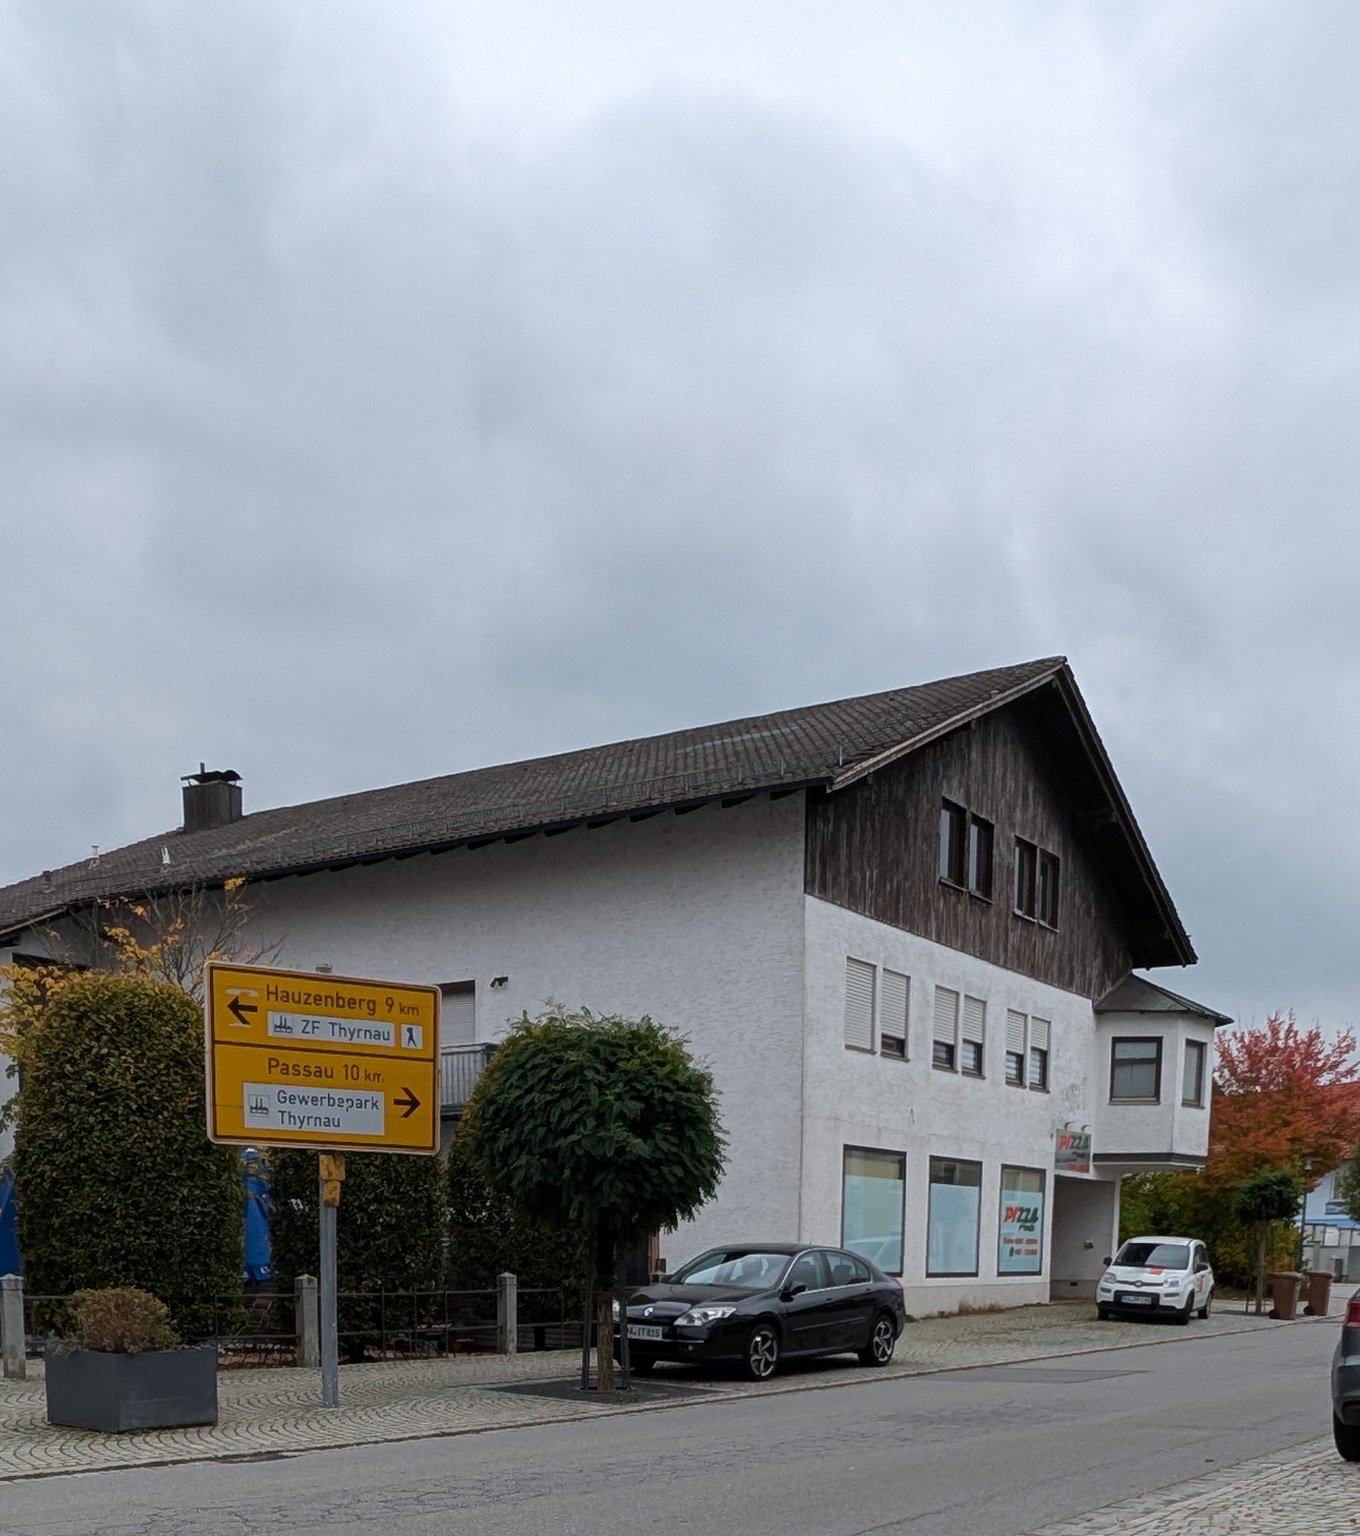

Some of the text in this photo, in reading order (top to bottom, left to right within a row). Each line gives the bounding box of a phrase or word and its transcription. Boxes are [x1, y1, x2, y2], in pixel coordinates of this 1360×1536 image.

[266, 984, 420, 1016] Hauzenberg 9 km
[301, 1018, 391, 1042] ZF Thyrnau
[267, 1057, 334, 1079] Passau
[342, 1063, 360, 1081] 10
[276, 1089, 380, 1112] Gewerbepark
[277, 1110, 341, 1130] Thyrnau
[1059, 1135, 1089, 1149] PIZZA
[1004, 1206, 1039, 1223] PIZZA
